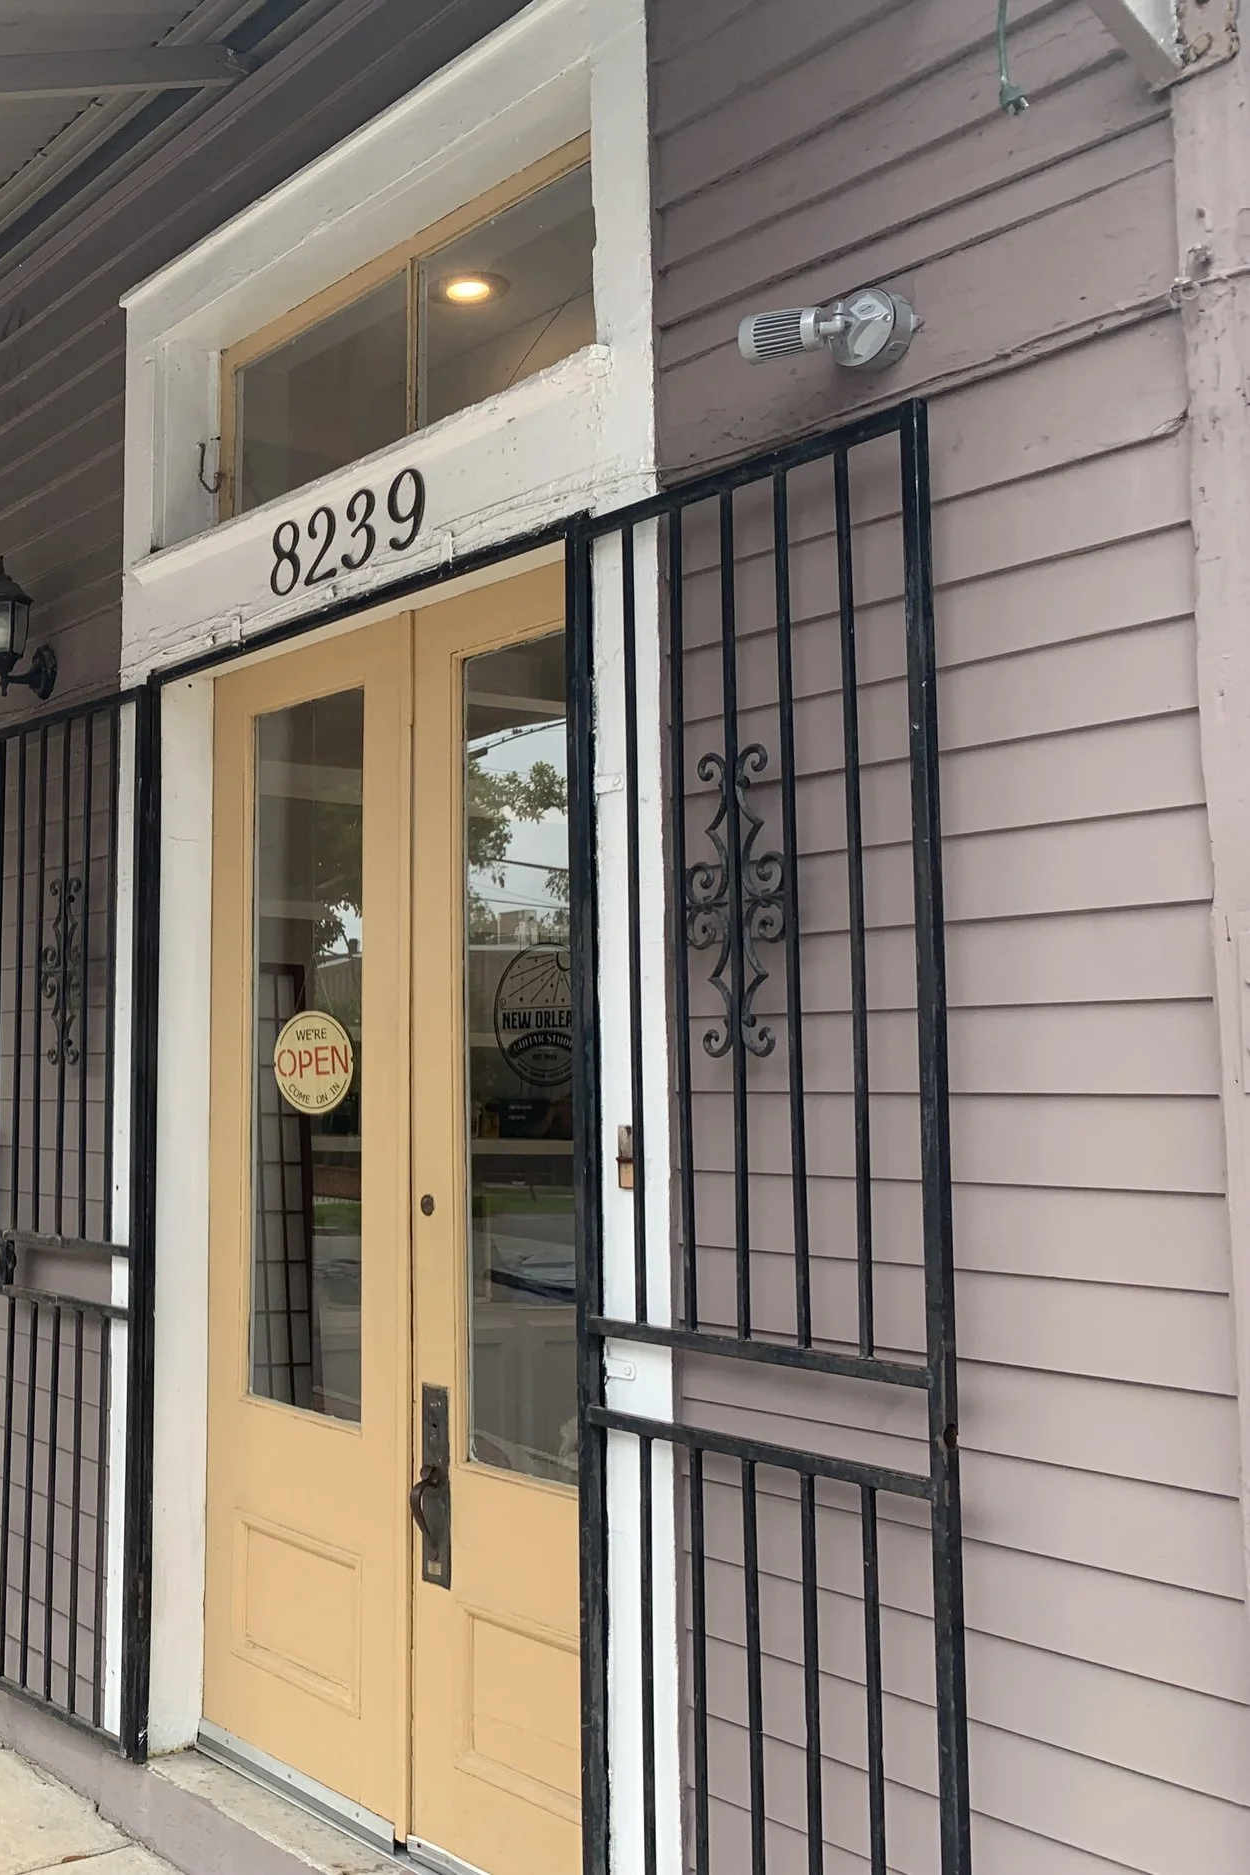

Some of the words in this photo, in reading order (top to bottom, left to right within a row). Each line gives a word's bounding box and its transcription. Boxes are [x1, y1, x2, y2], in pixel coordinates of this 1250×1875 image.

[270, 467, 426, 597] 8239
[502, 1011, 531, 1030] NEW
[295, 1028, 327, 1041] WE'RE
[277, 1044, 349, 1079] OPEN
[288, 1083, 310, 1104] COME
[316, 1092, 328, 1104] ON
[329, 1081, 340, 1095] IN
